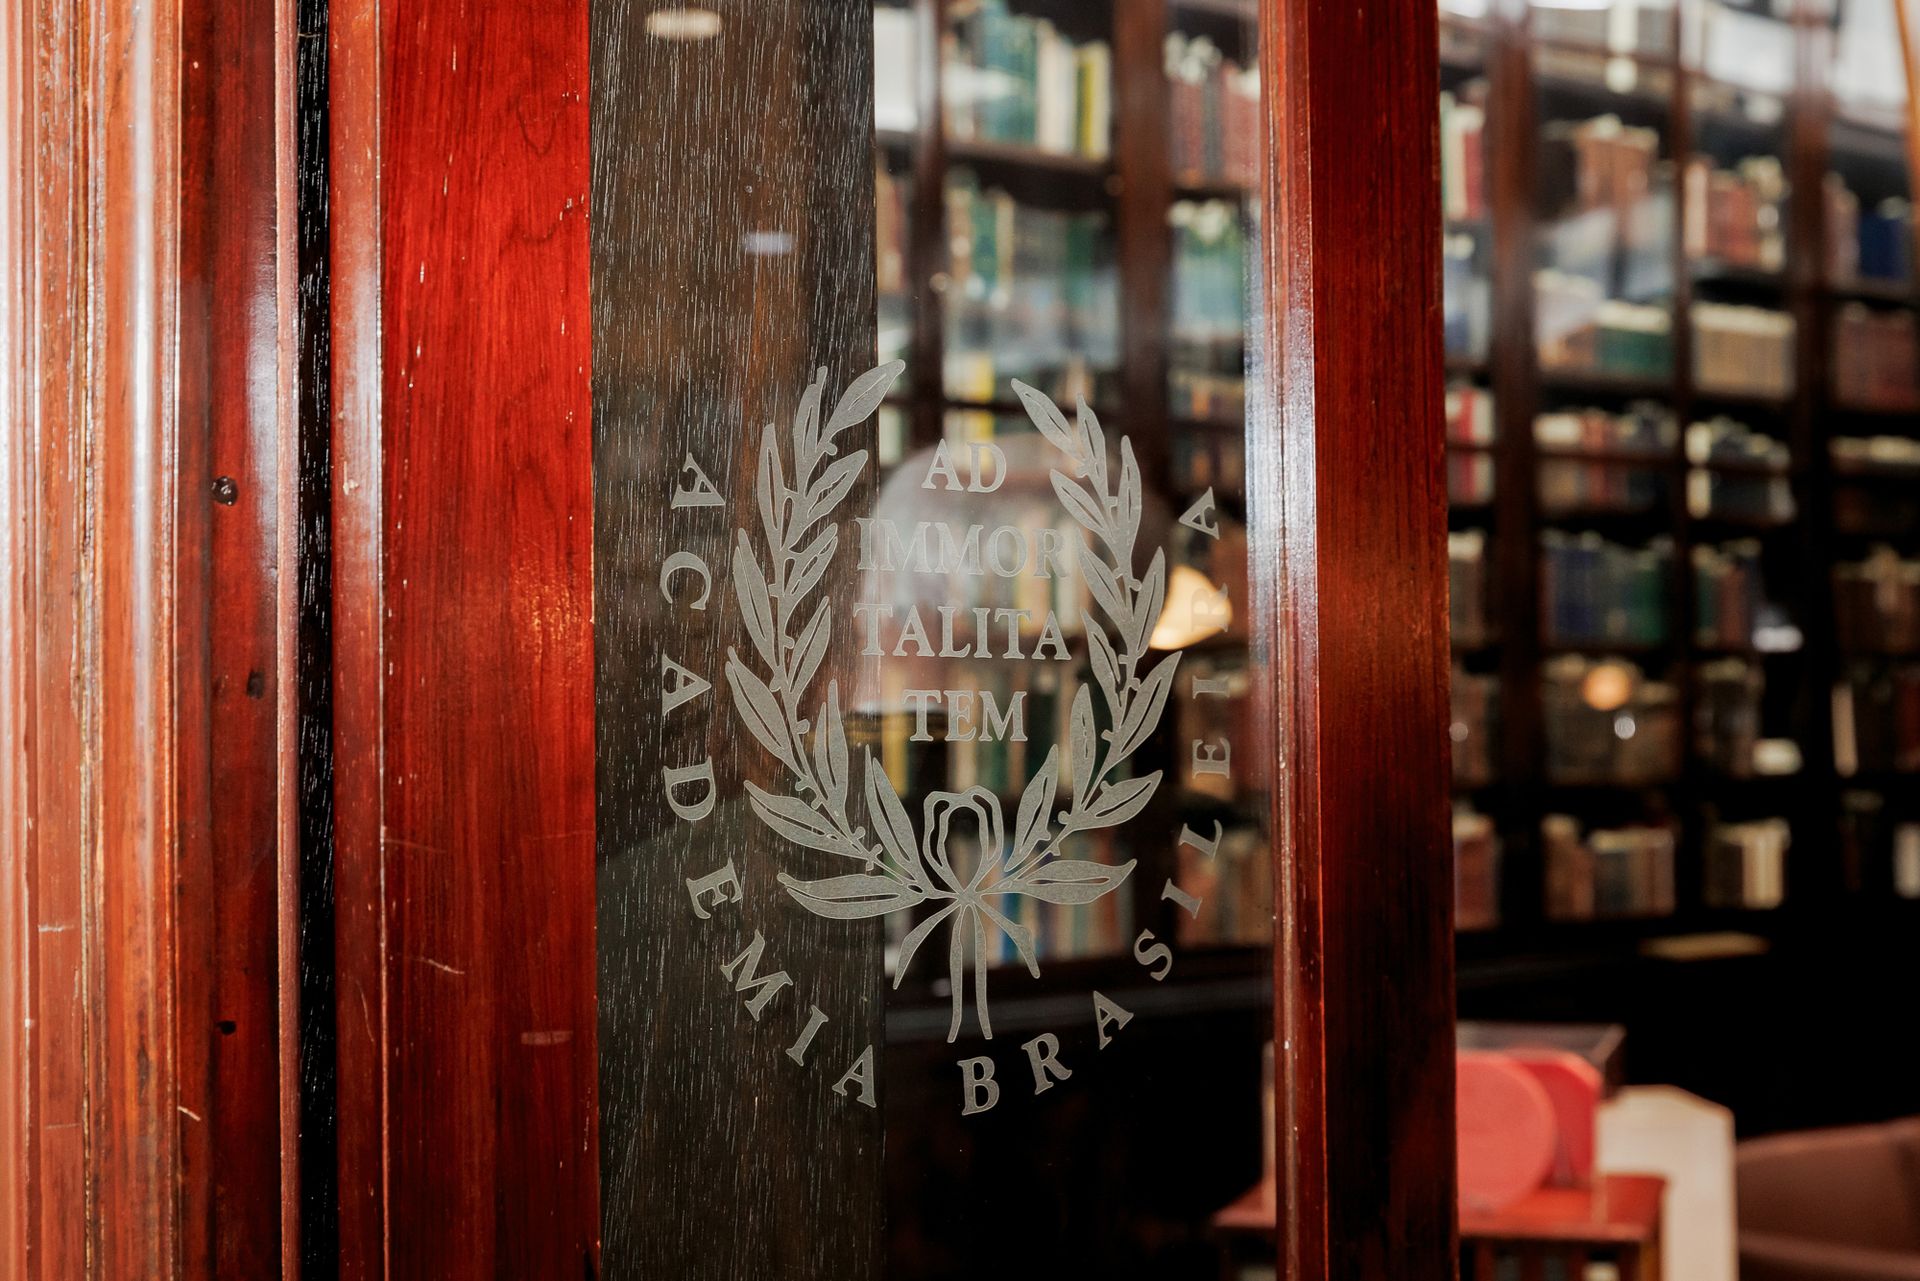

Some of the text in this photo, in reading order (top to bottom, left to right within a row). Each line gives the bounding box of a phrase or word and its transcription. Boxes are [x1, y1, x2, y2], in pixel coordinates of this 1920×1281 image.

[922, 438, 1007, 493] AD
[855, 517, 1072, 578] IMMOR
[853, 604, 1072, 660] TALITA
[905, 690, 1028, 742] TEM
[659, 453, 1232, 1116] ACADEMIA BRASILEIRA
